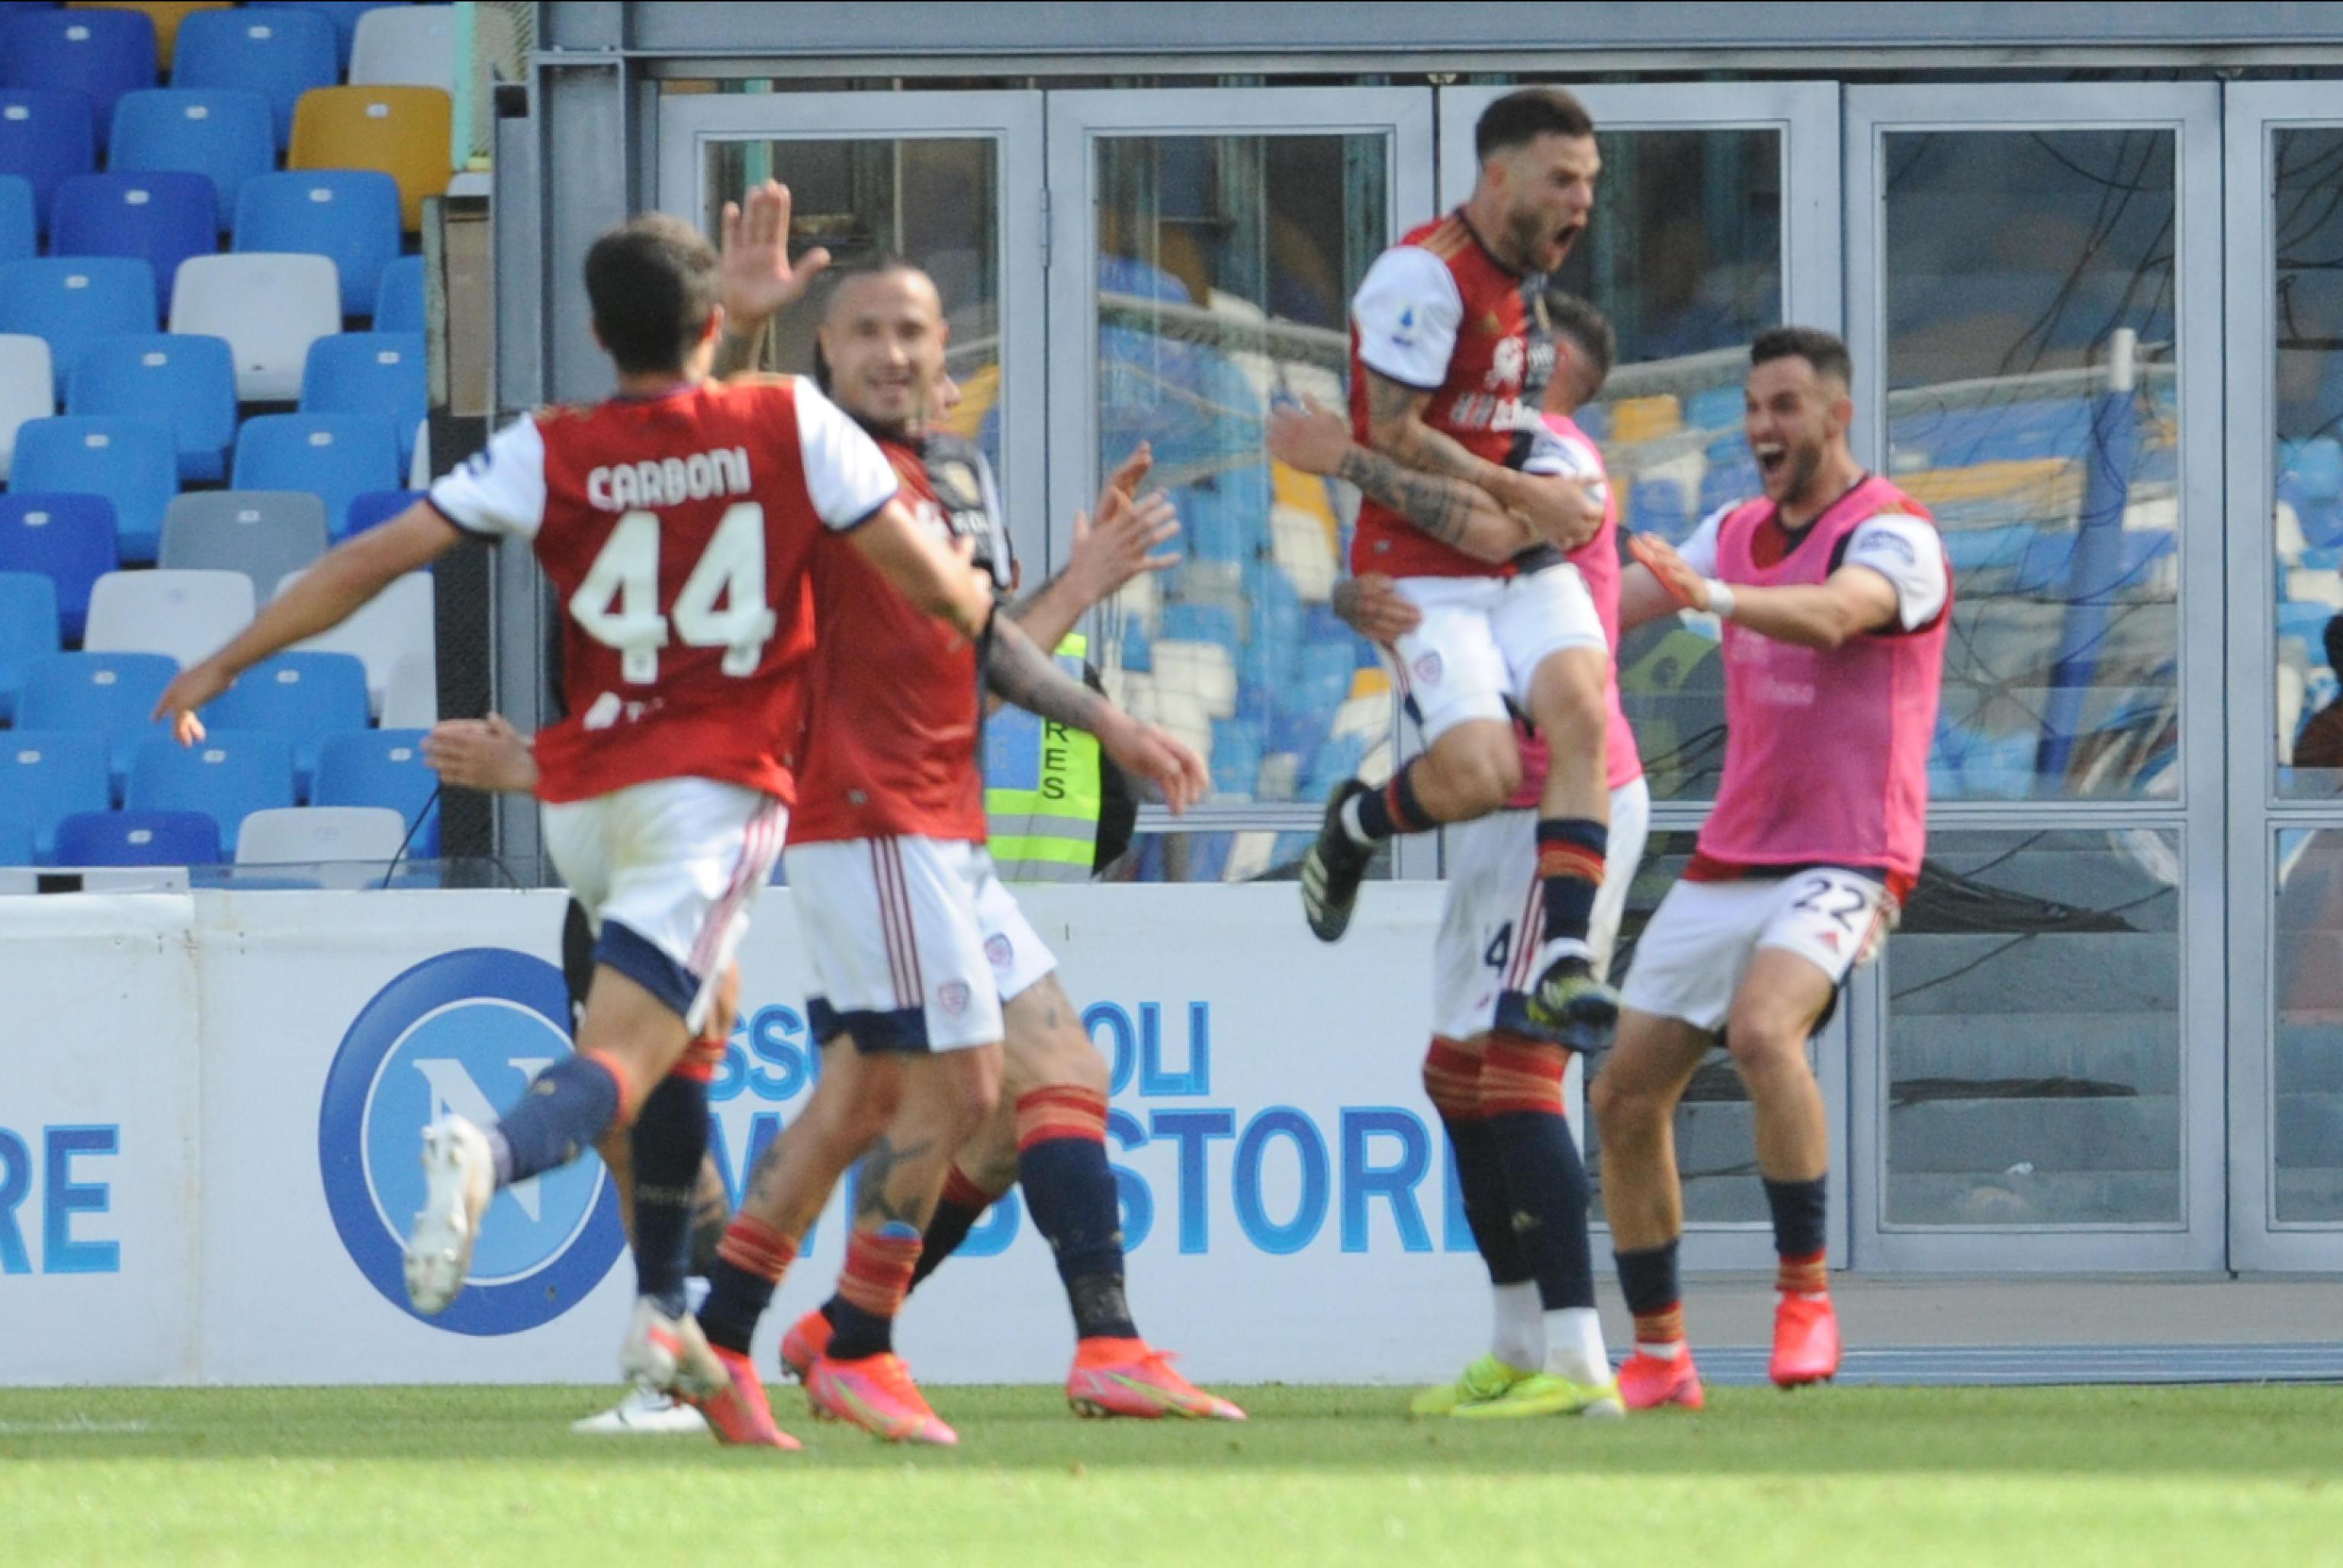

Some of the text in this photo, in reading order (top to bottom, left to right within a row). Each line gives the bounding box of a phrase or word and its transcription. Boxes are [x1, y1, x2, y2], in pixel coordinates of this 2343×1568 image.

[587, 446, 751, 512] CARBONI
[569, 500, 776, 685] 44
[1792, 877, 1866, 932] 22
[1484, 919, 1512, 977] 4
